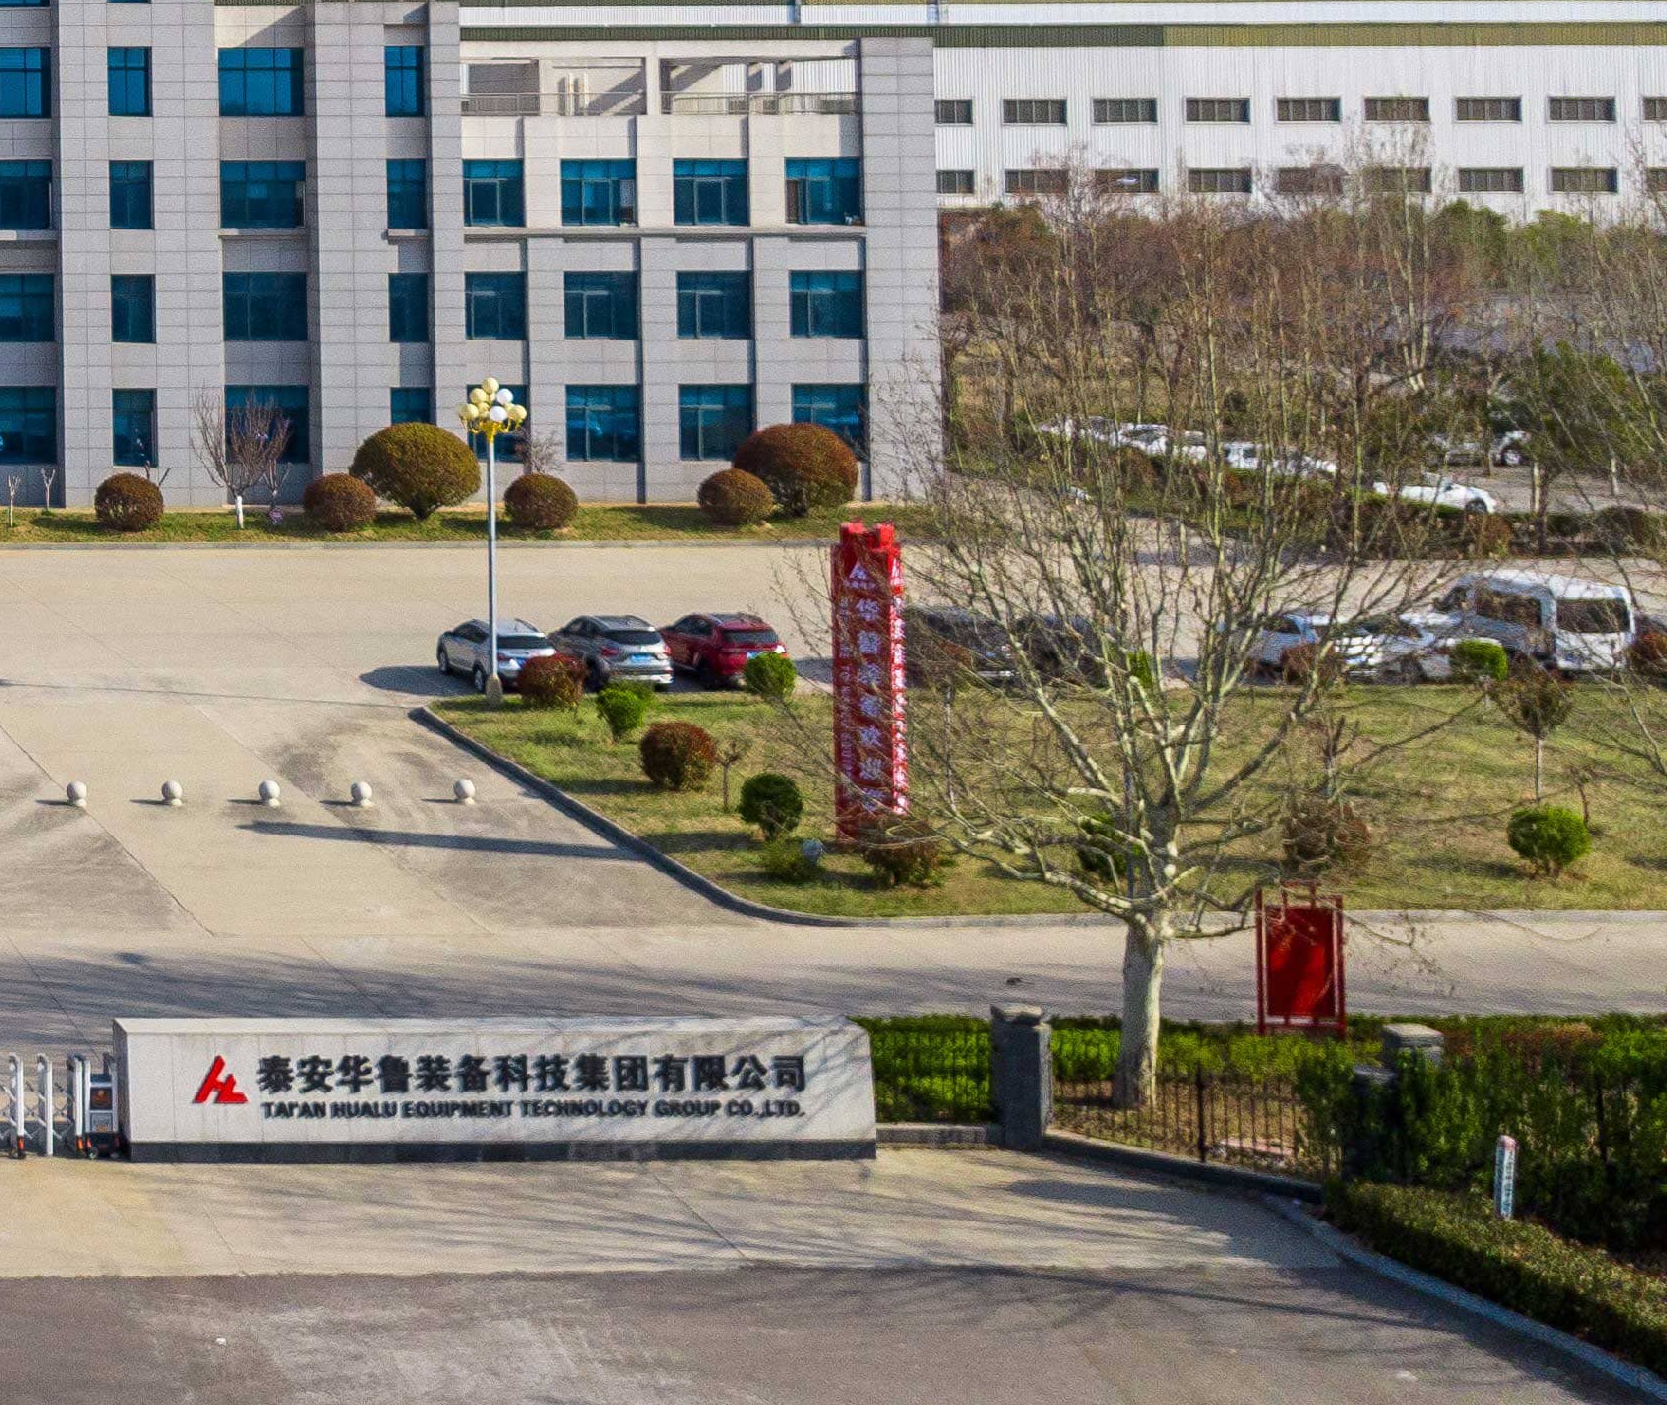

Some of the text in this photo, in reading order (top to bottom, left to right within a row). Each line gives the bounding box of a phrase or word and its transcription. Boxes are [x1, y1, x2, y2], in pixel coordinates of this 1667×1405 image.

[256, 1055, 805, 1094] 泰安华鲁装备科技集团有限公司
[330, 1100, 397, 1119] HUALU
[401, 1099, 513, 1118] EQUIPMENT
[520, 1099, 649, 1118] TECHNOLOGY
[654, 1099, 722, 1117] GROUP
